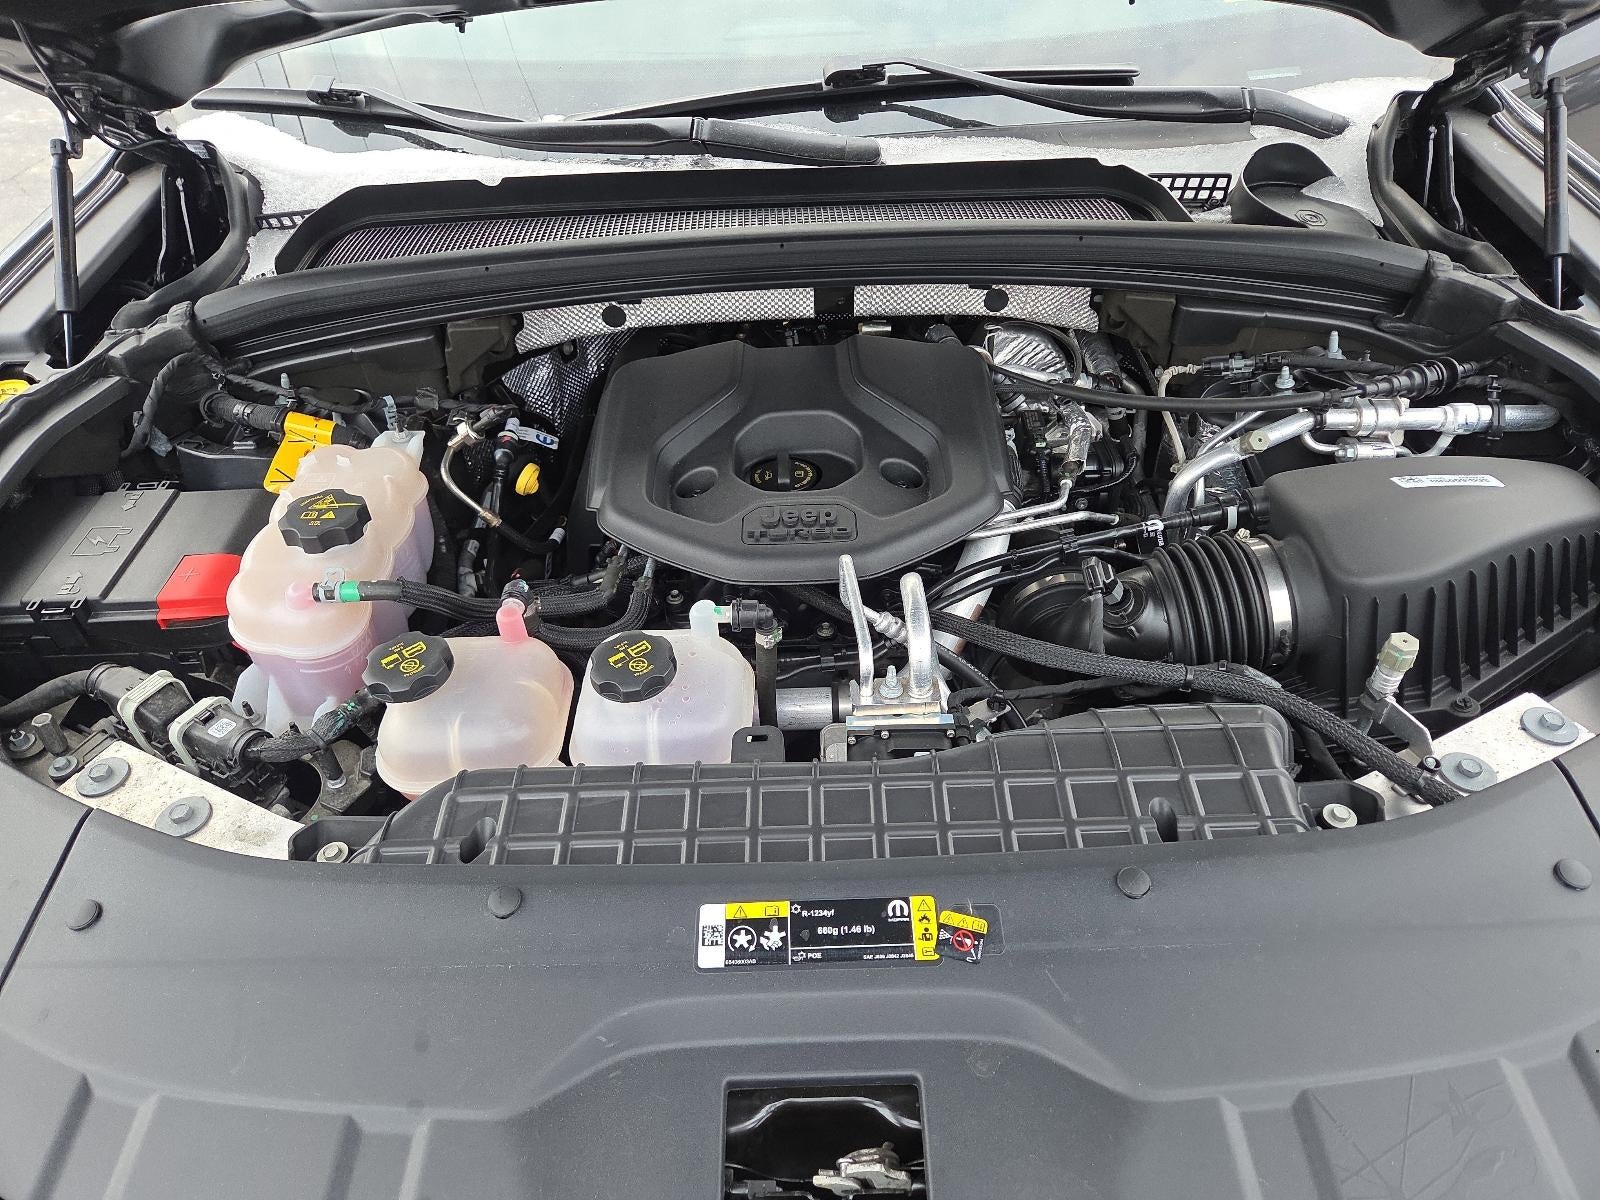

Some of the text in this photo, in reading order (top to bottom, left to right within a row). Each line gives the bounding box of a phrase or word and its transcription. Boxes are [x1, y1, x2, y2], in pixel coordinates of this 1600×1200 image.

[760, 507, 838, 529] Jeep
[801, 908, 835, 918] R-1234yf
[863, 924, 876, 935] lb)
